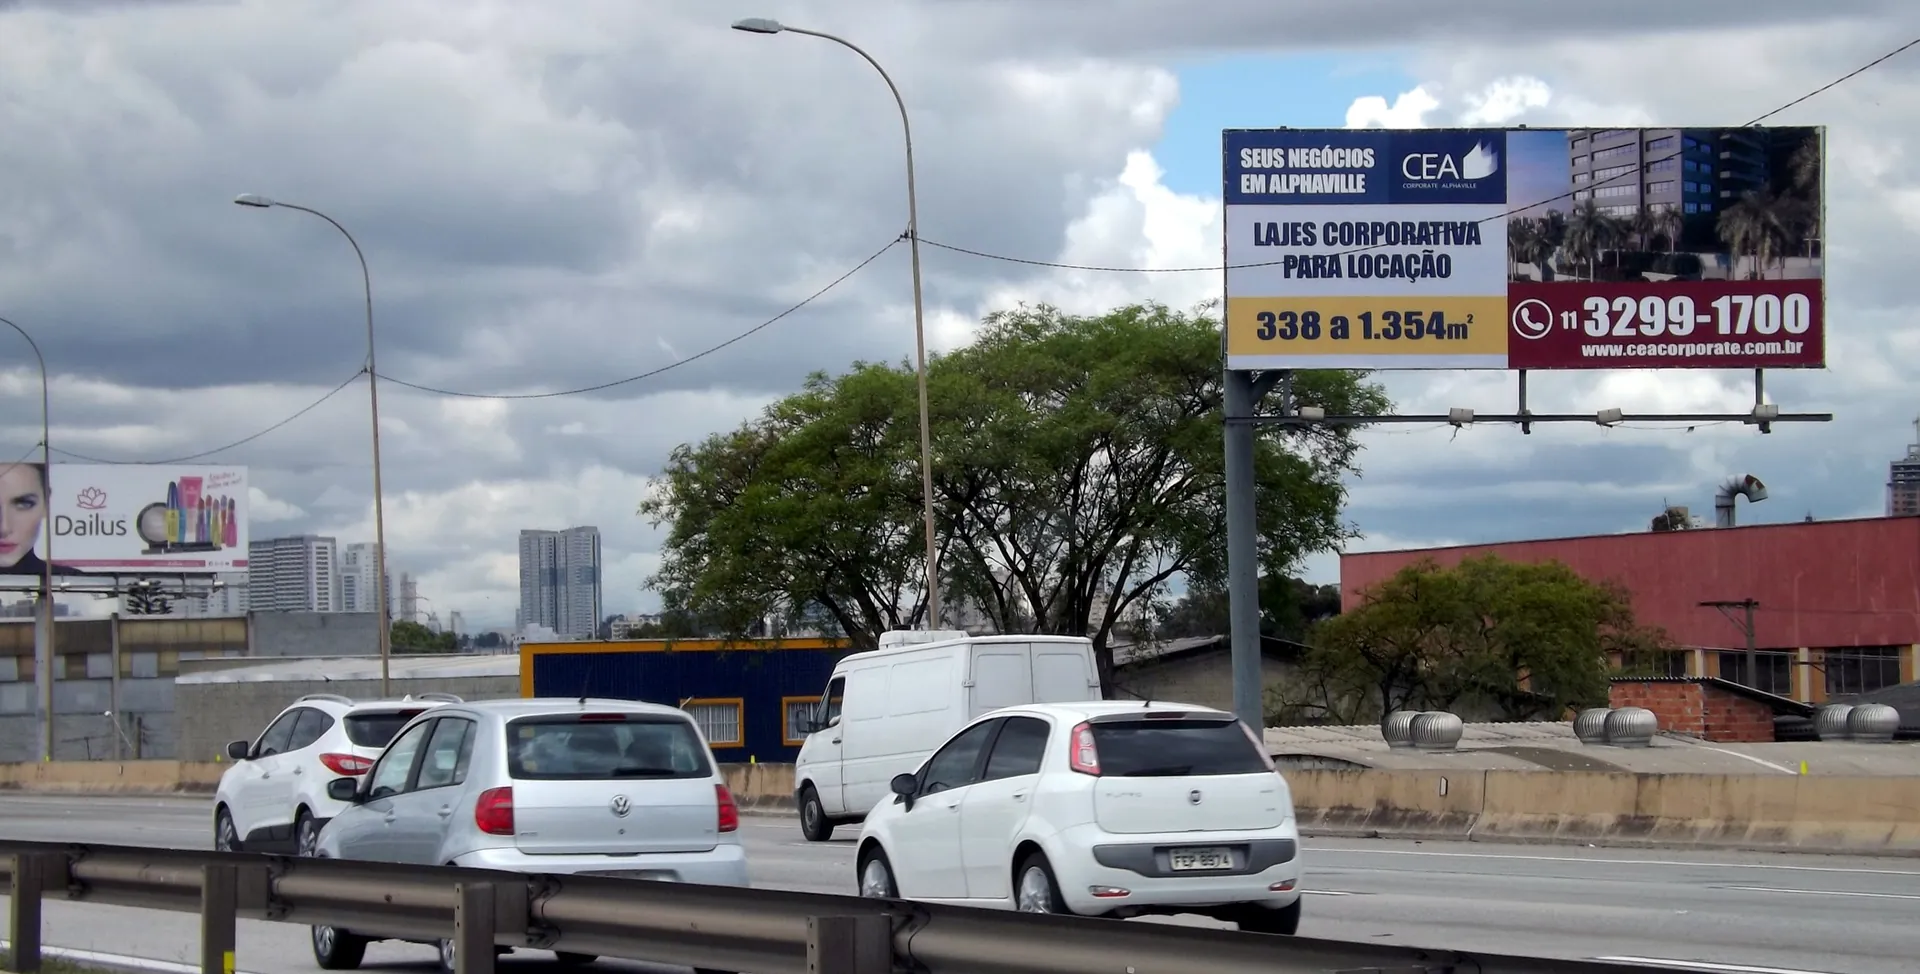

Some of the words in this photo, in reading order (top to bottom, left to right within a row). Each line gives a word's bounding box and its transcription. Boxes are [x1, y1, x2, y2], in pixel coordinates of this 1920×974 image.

[1240, 148, 1286, 168] SEUS
[1288, 144, 1375, 168] NEGÓCIOS
[1402, 153, 1460, 180] CEA
[1241, 173, 1266, 194] EM
[1269, 173, 1366, 194] ALPHAVILLE
[1254, 222, 1317, 247] LAJES
[1323, 221, 1482, 246] CORPORATIVA
[1283, 254, 1343, 279] PARA
[1348, 249, 1452, 283] LOCAÇÃO
[1256, 311, 1321, 340] 338
[1330, 315, 1350, 340] a
[1560, 310, 1577, 329] 11
[1583, 293, 1811, 337] 3299-1700
[1582, 340, 1804, 358] www.ceacorporate.com.br
[55, 514, 127, 537] Dailus
